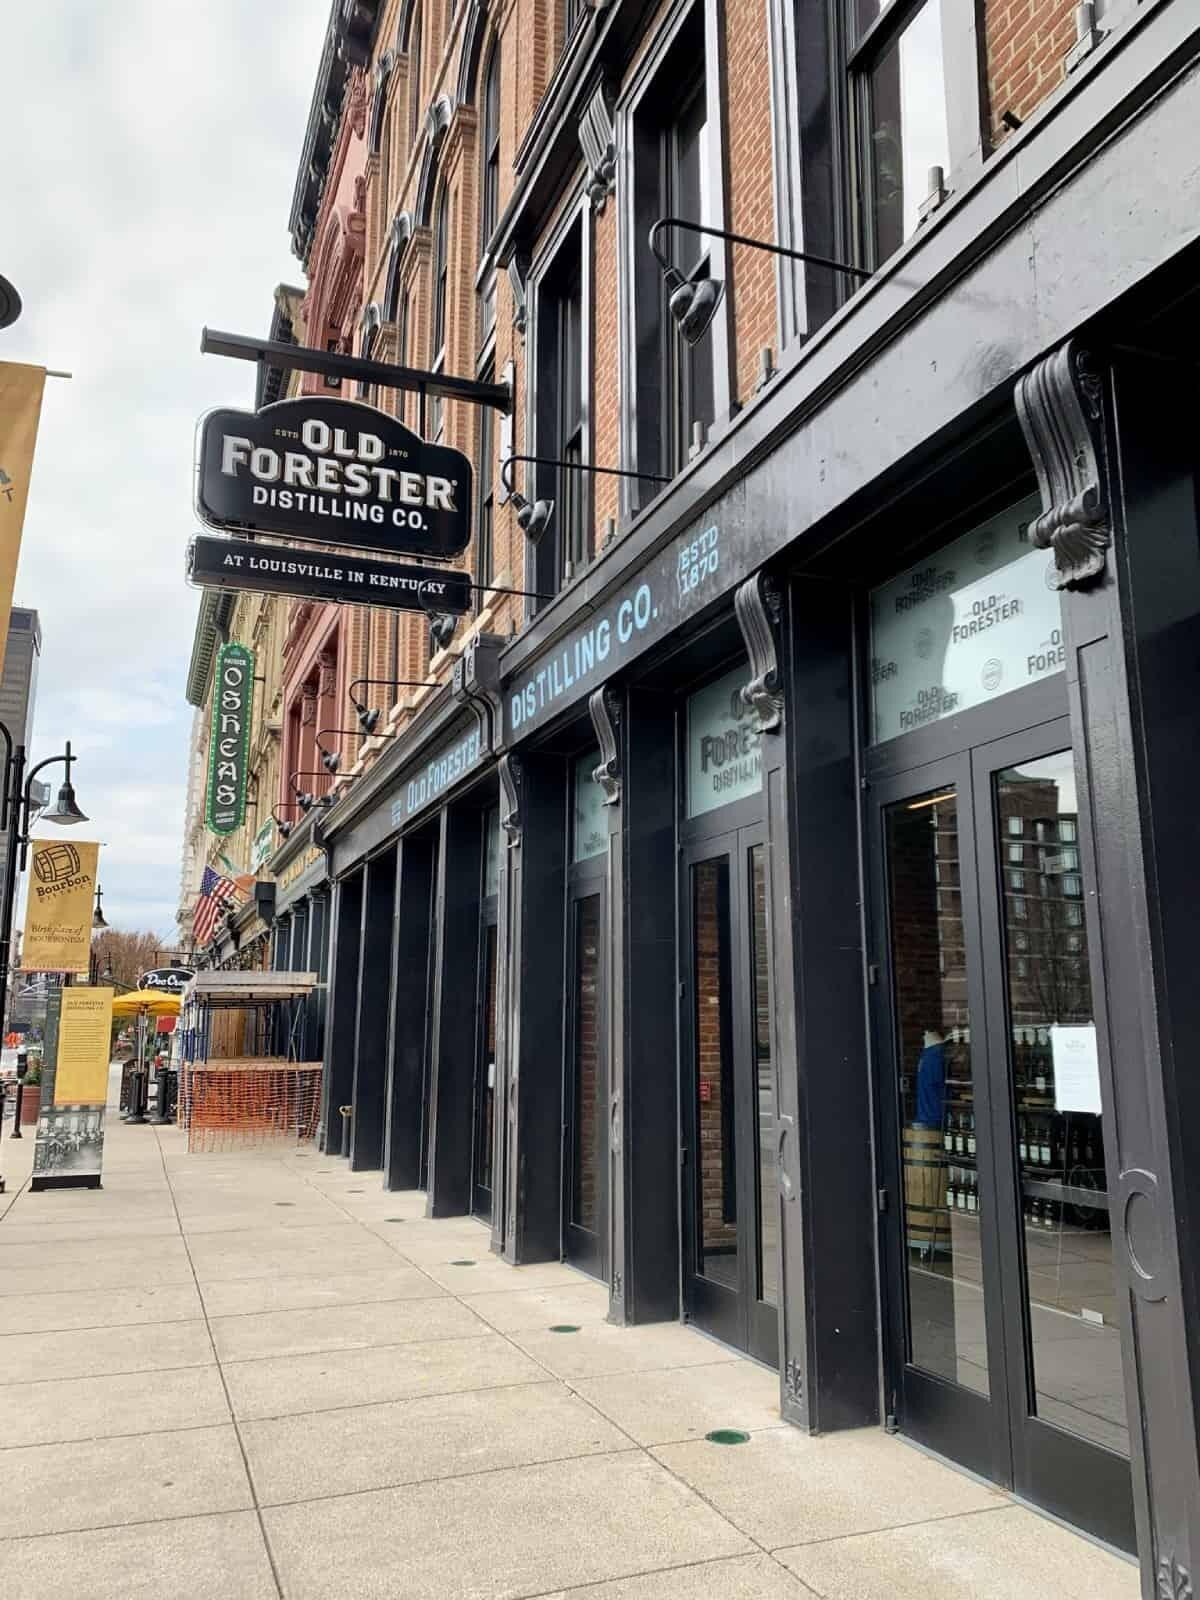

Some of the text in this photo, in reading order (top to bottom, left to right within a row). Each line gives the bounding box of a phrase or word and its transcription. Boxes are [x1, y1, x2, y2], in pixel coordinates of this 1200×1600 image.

[302, 419, 385, 462] OLD
[221, 434, 458, 512] FORESTER
[253, 486, 429, 531] DISTILLING CO.
[223, 554, 244, 567] AT
[249, 558, 343, 581] LOUISVILLE
[347, 571, 365, 584] IN
[679, 525, 719, 571] ESTD
[680, 550, 719, 594] 1870
[952, 599, 1020, 644] FORESTER
[972, 595, 997, 618] OLD
[511, 584, 658, 729] DISTILLING CO.
[1026, 646, 1066, 676] FORE
[900, 692, 960, 729] FORESTER
[918, 686, 938, 705] OLD
[700, 722, 757, 774] FORE
[407, 778, 426, 814] OLD
[36, 874, 91, 897] Bourbon
